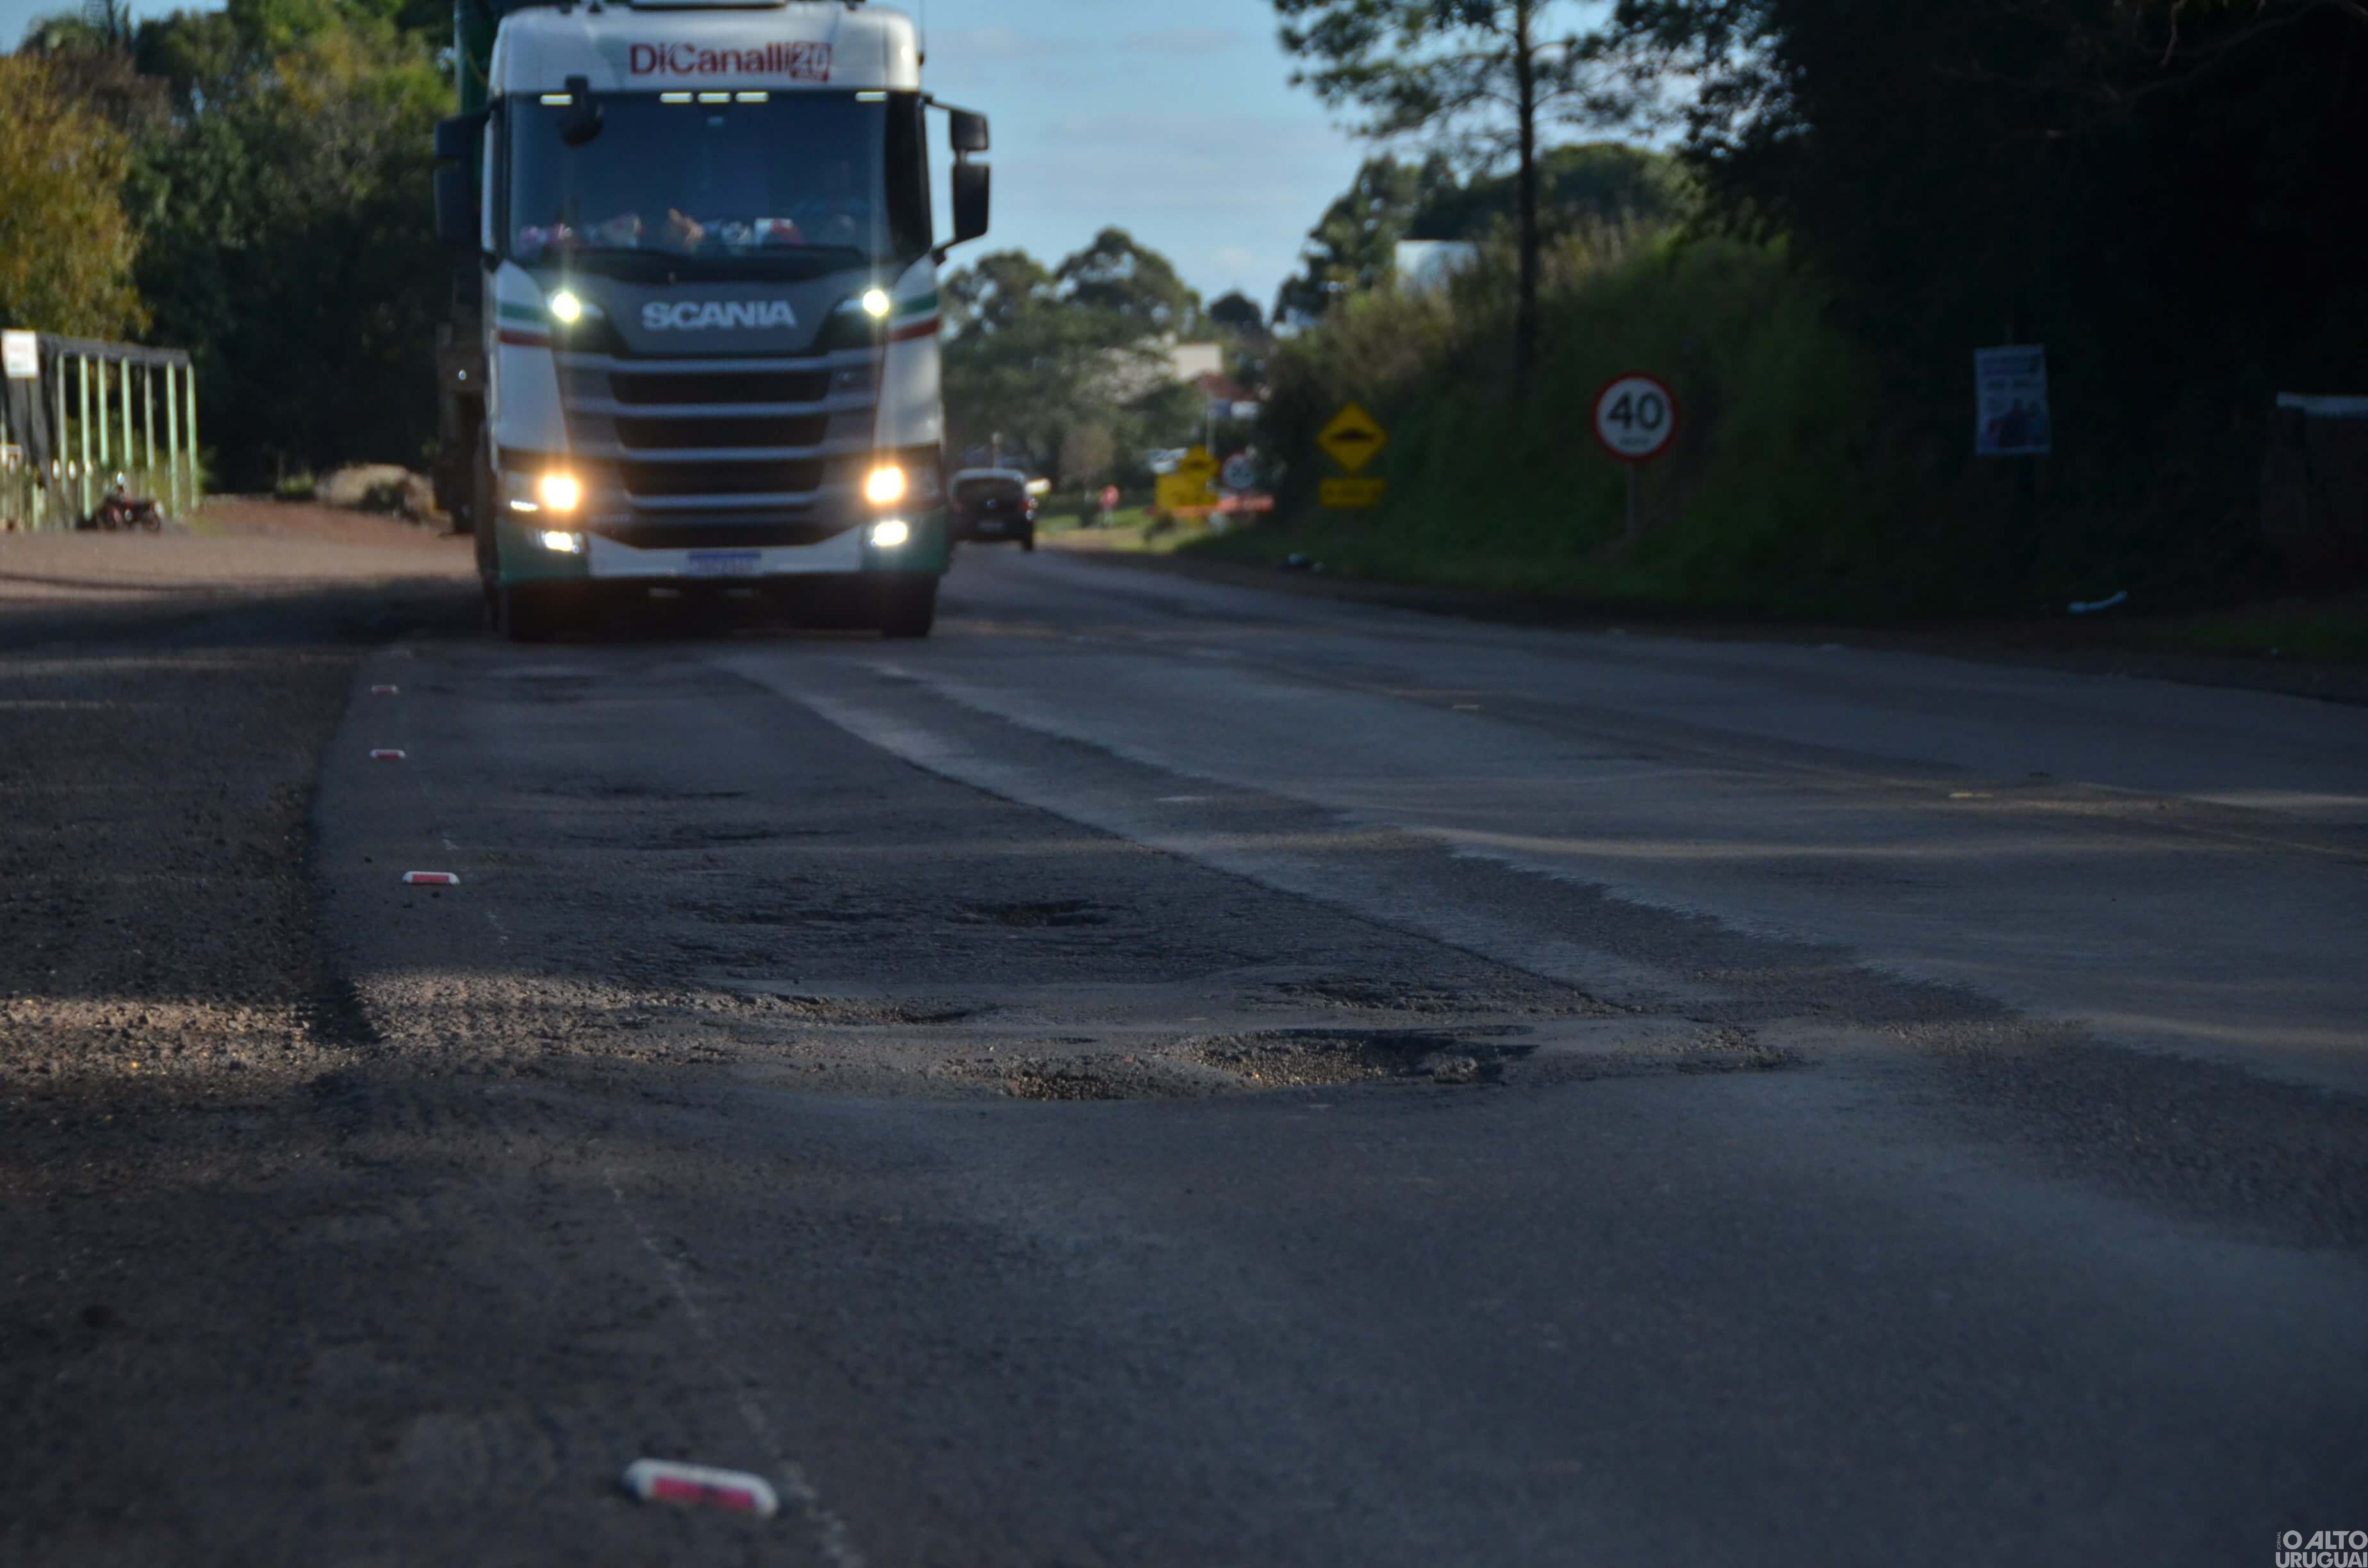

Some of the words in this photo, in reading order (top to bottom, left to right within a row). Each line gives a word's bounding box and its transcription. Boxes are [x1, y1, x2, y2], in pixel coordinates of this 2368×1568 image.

[629, 41, 790, 76] DiCanalli
[641, 300, 796, 330] SCANIA
[1607, 391, 1665, 431] 40
